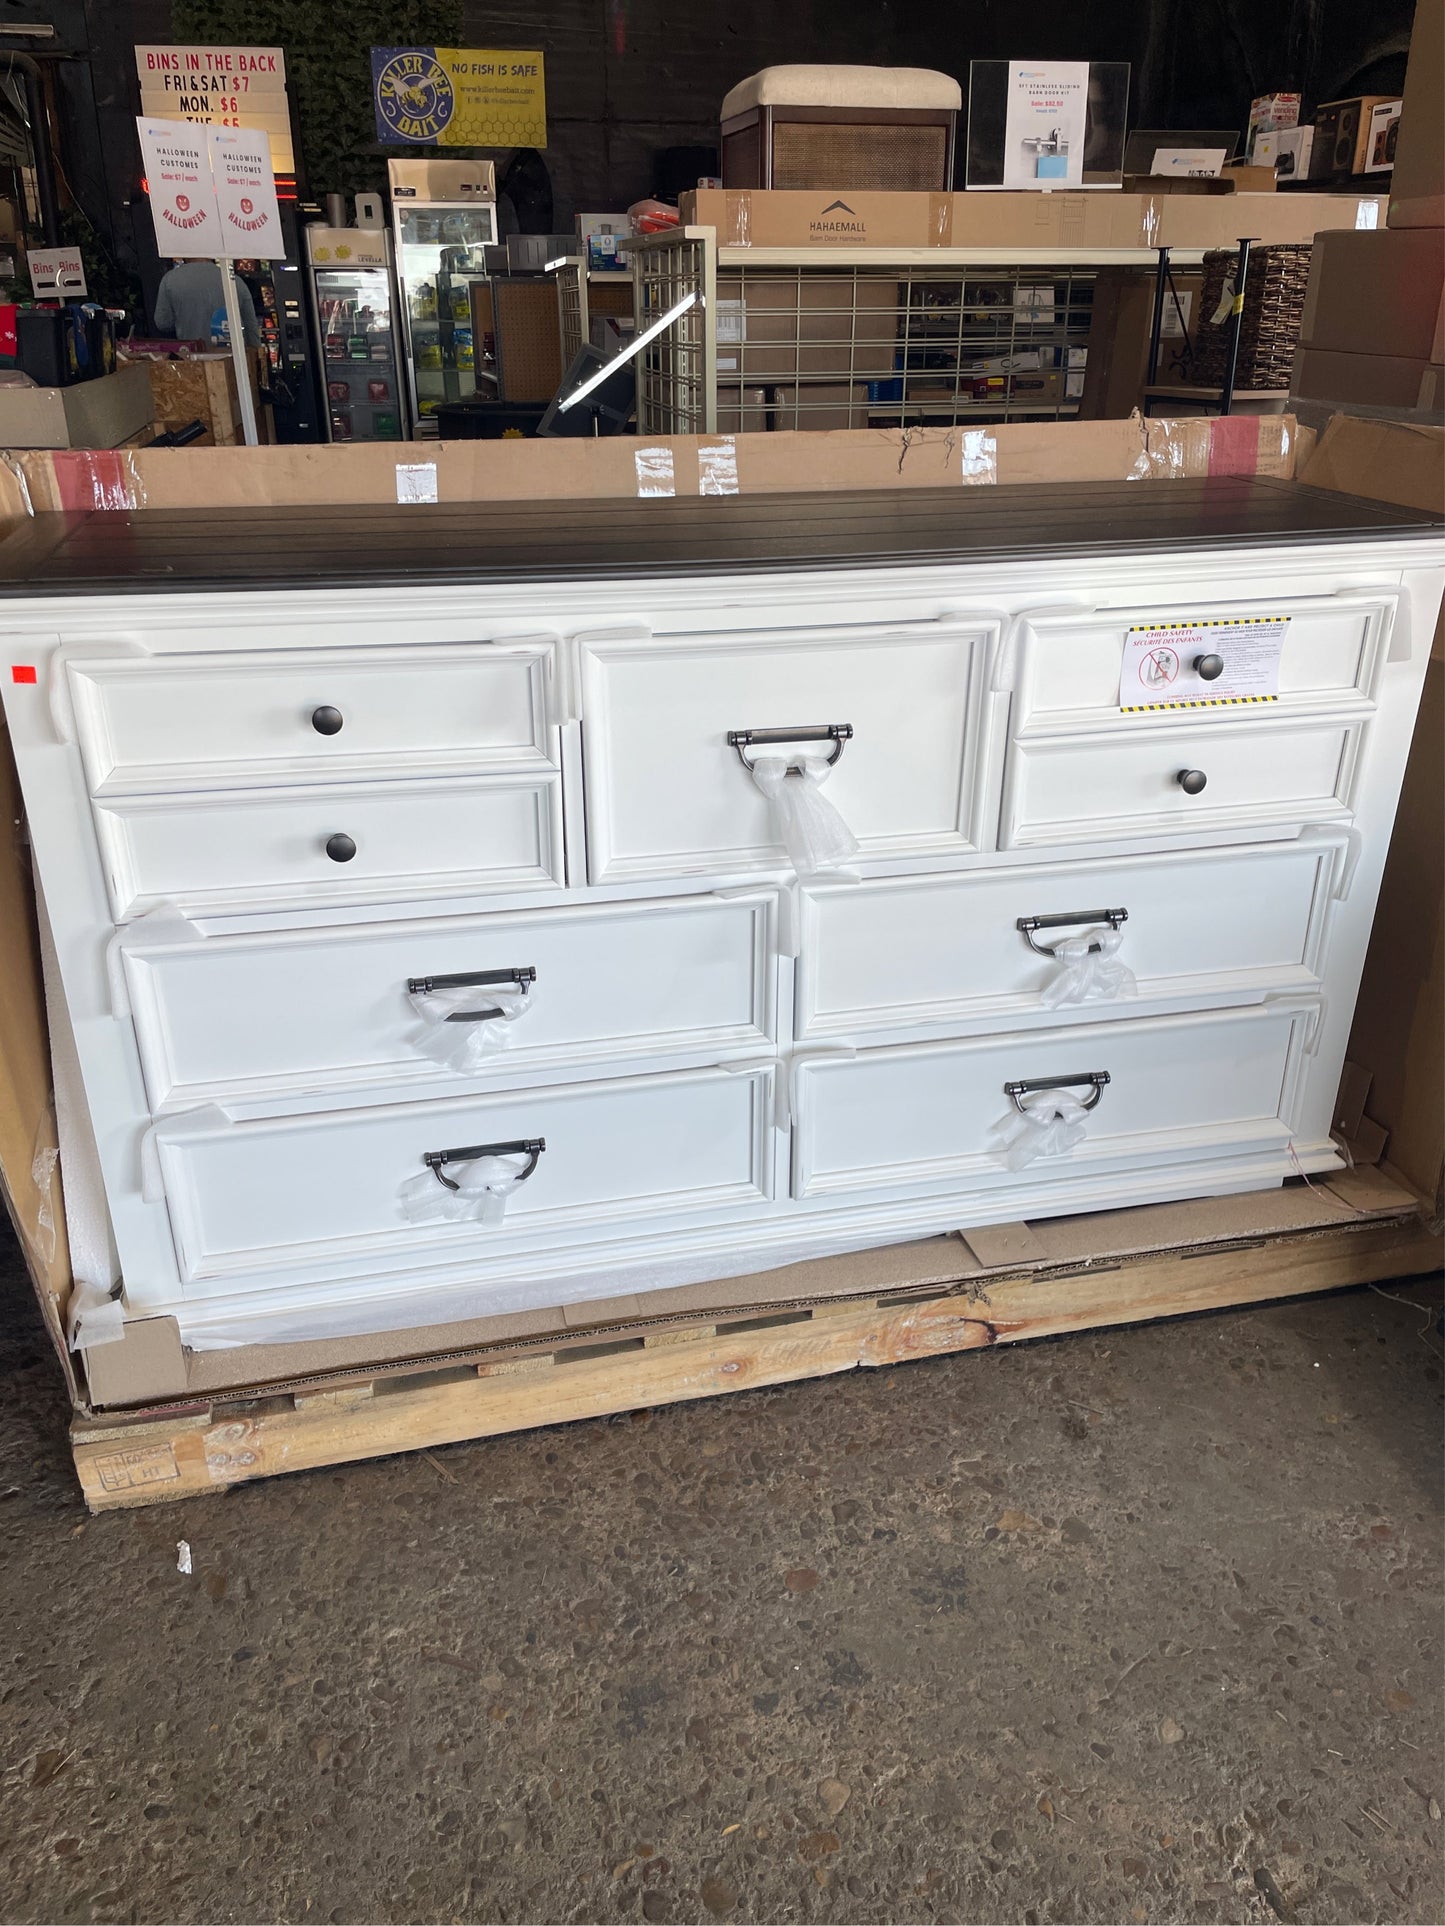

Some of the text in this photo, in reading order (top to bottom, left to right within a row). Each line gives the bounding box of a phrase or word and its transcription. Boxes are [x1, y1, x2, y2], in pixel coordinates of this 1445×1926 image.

[147, 54, 276, 72] BINS IN THE BACK
[381, 56, 452, 98] KILLER BEE
[452, 64, 538, 77] NO FISH IS SAFE
[164, 75, 249, 92] FRI&SAT $7
[180, 96, 237, 112] MON. $6
[397, 114, 439, 136] BAIT
[156, 148, 199, 158] HALLOWEEN
[223, 153, 262, 163] HALLOWEEN
[160, 159, 199, 169] CUSTOMES
[227, 165, 261, 174] CUSTOMES
[162, 209, 207, 229] HALLOWEEN
[228, 212, 268, 231] HALLOWEEN
[810, 222, 866, 232] HAHAEMALL
[33, 261, 80, 274] Bins Bins
